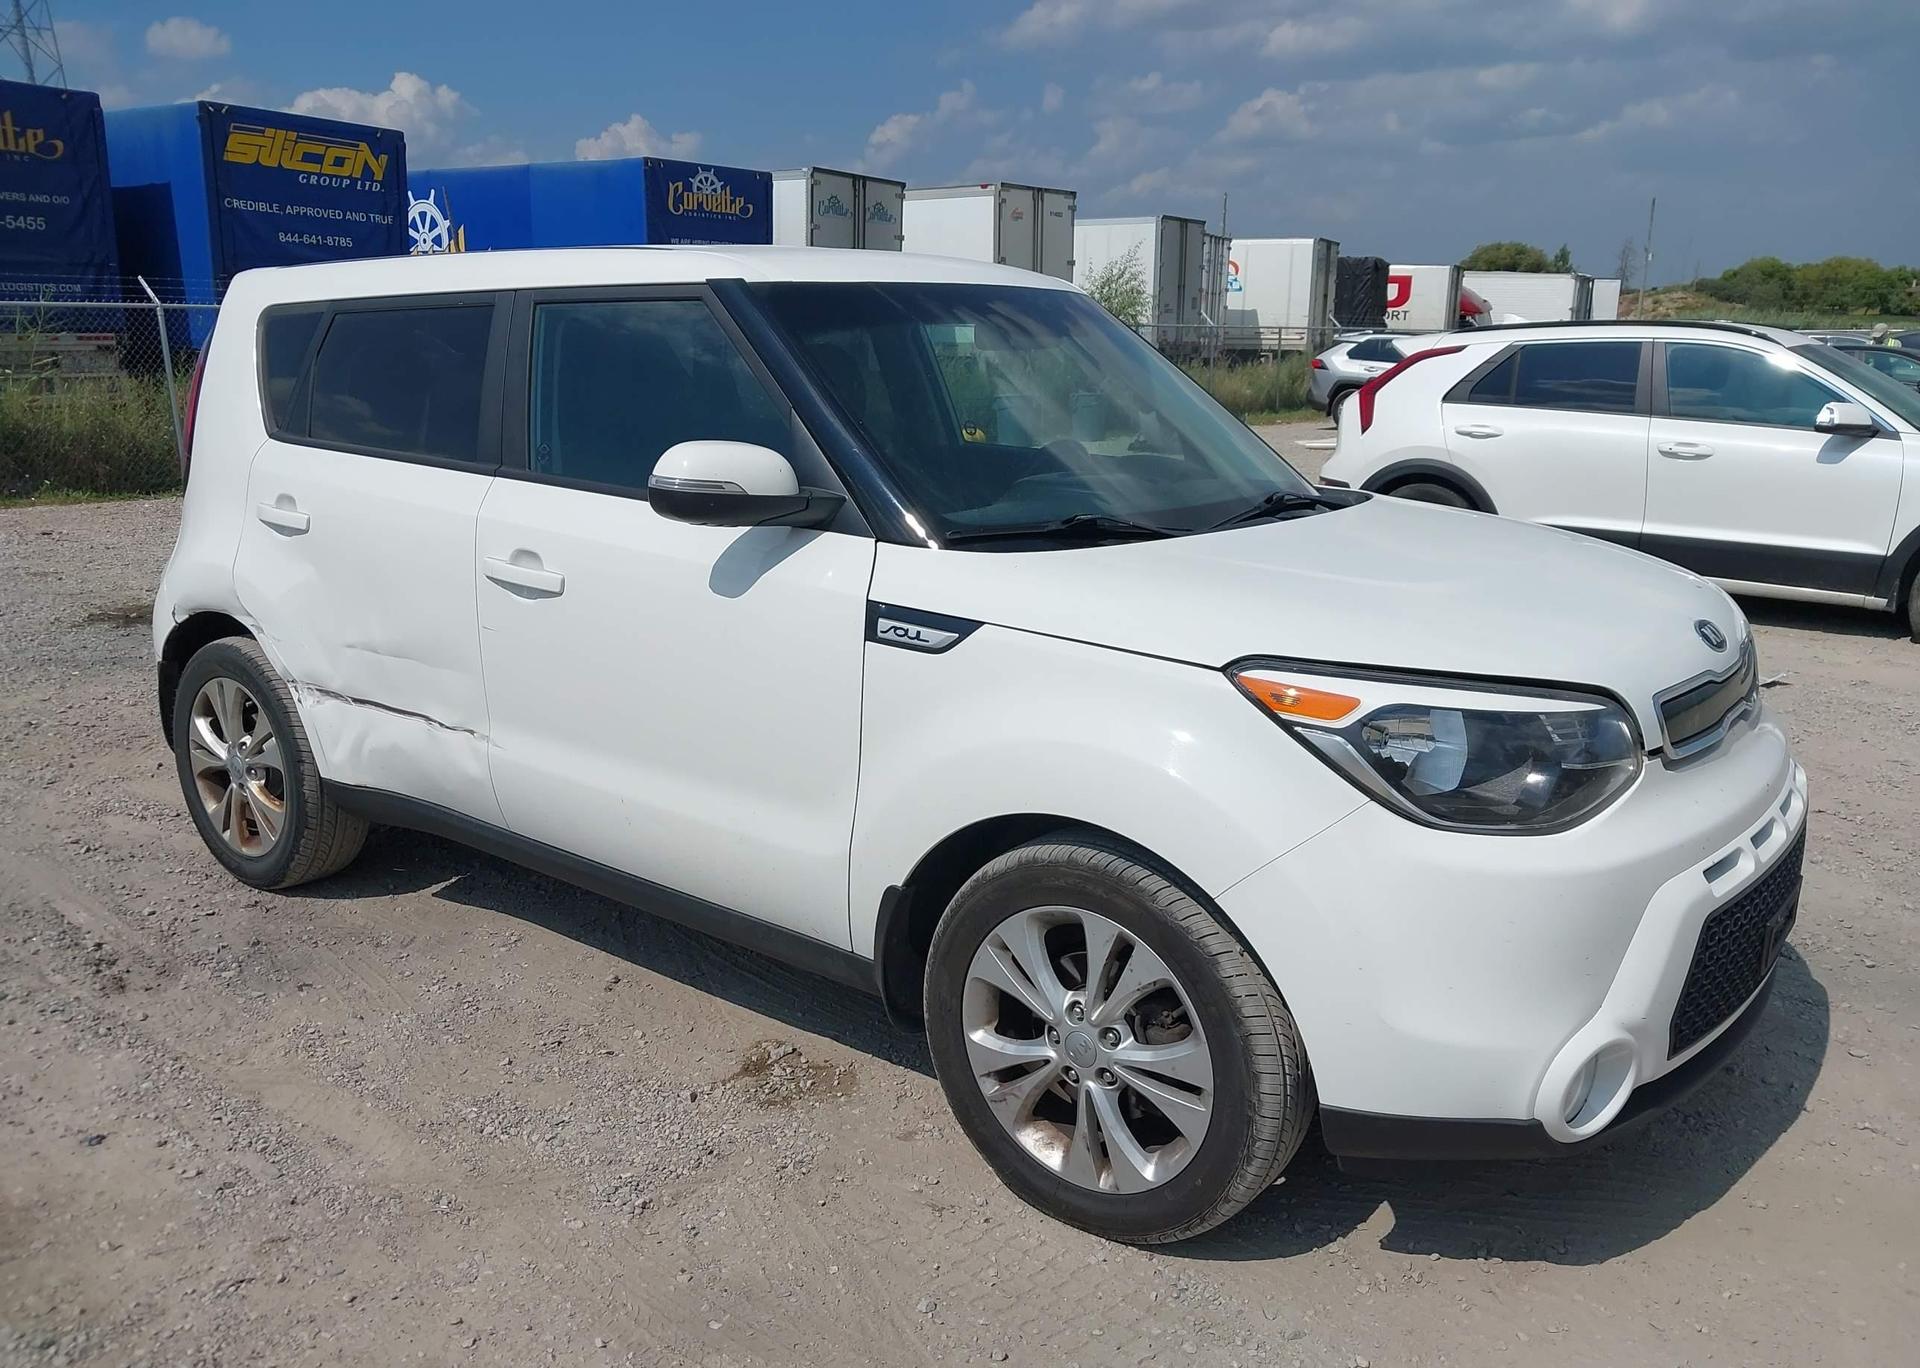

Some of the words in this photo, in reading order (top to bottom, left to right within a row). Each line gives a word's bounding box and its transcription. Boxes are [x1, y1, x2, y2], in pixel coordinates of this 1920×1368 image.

[298, 173, 351, 189] GROUP
[356, 181, 385, 193] LTD.
[28, 194, 51, 204] AND
[224, 197, 284, 216] CREDIBLE,
[285, 205, 344, 220] APPROVED
[345, 211, 367, 222] AND
[368, 213, 394, 225] TRUE
[278, 231, 353, 248] 844-641-8785
[0, 281, 83, 293] LOGISTICS.COM
[879, 625, 930, 643] SOUL
